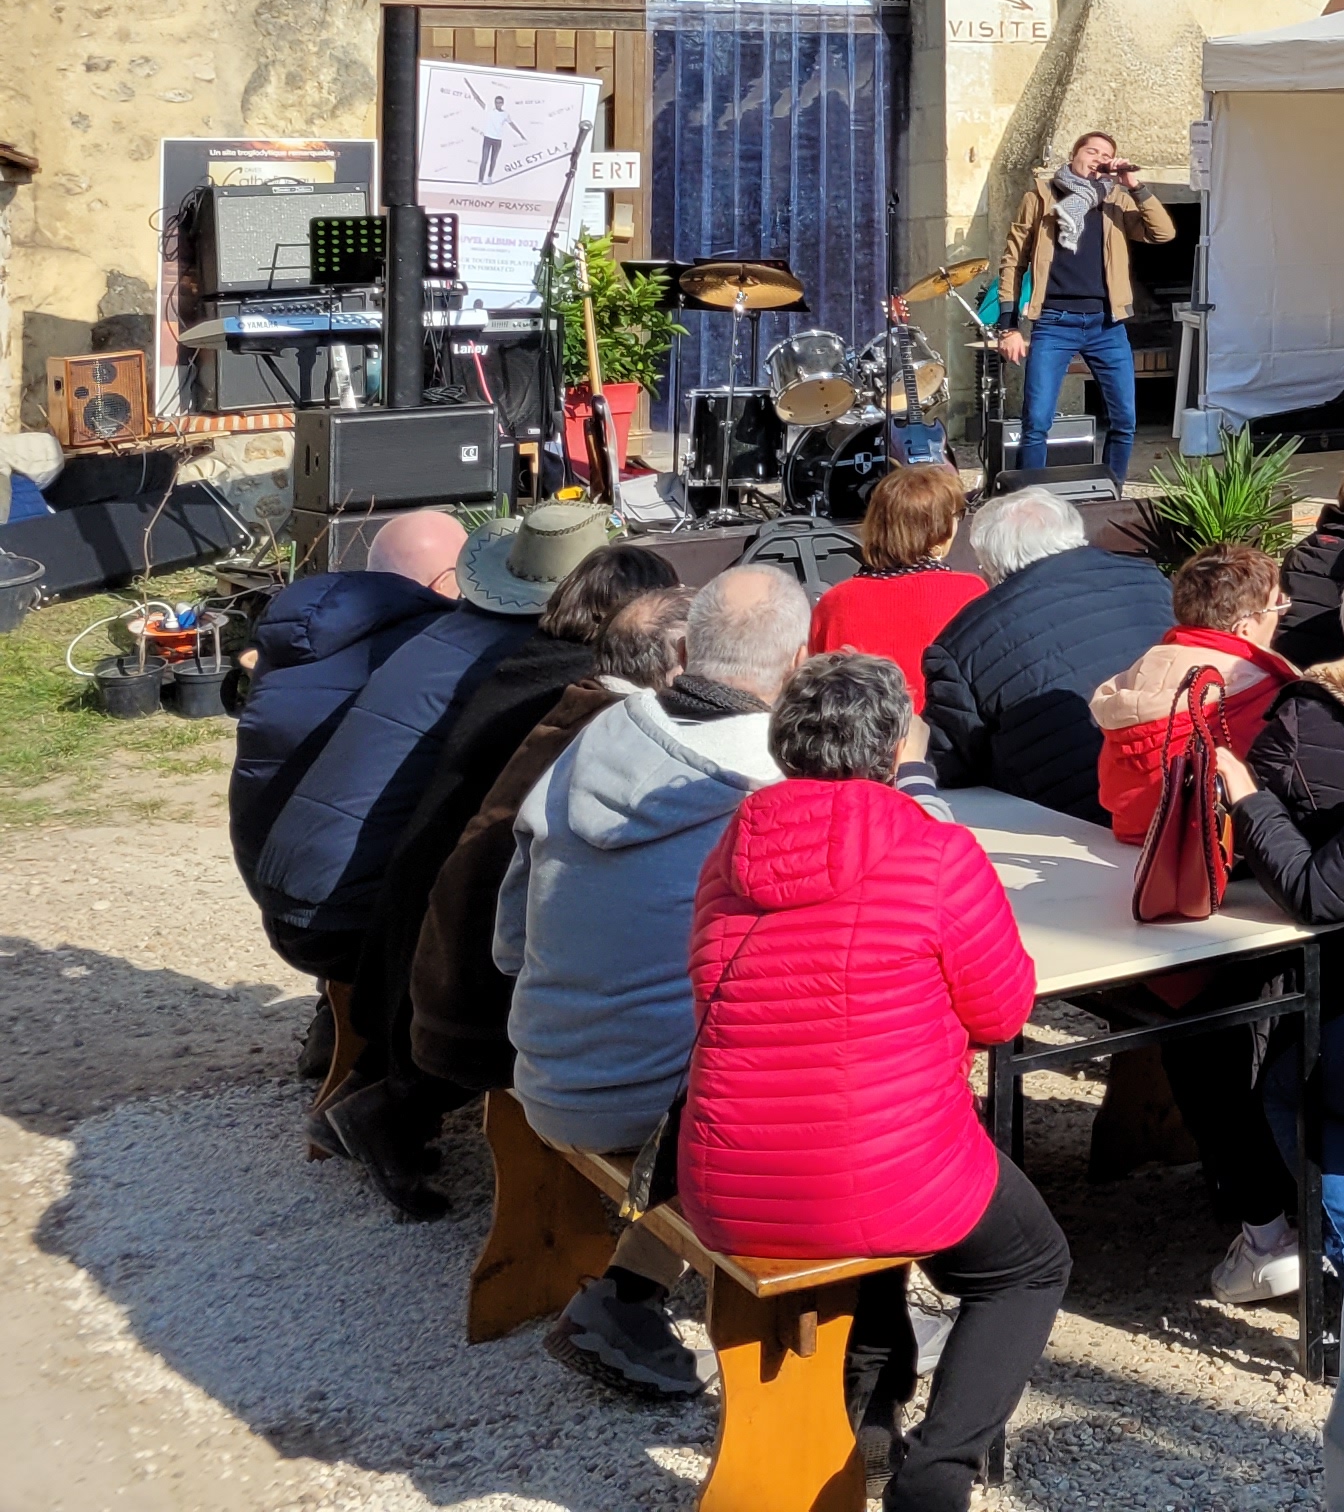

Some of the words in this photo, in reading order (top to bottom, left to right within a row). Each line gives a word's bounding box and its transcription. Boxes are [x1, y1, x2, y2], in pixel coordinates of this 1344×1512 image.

[949, 20, 1048, 38] VISITE
[288, 149, 335, 158] remarquable
[504, 160, 523, 173] QUI
[526, 152, 544, 165] EST
[547, 145, 562, 157] LA
[563, 142, 569, 151] ?
[449, 198, 495, 209] ANTHONY
[499, 201, 541, 212] FRAYSSE
[247, 321, 278, 329] YAMAHA
[453, 343, 489, 355] Laney
